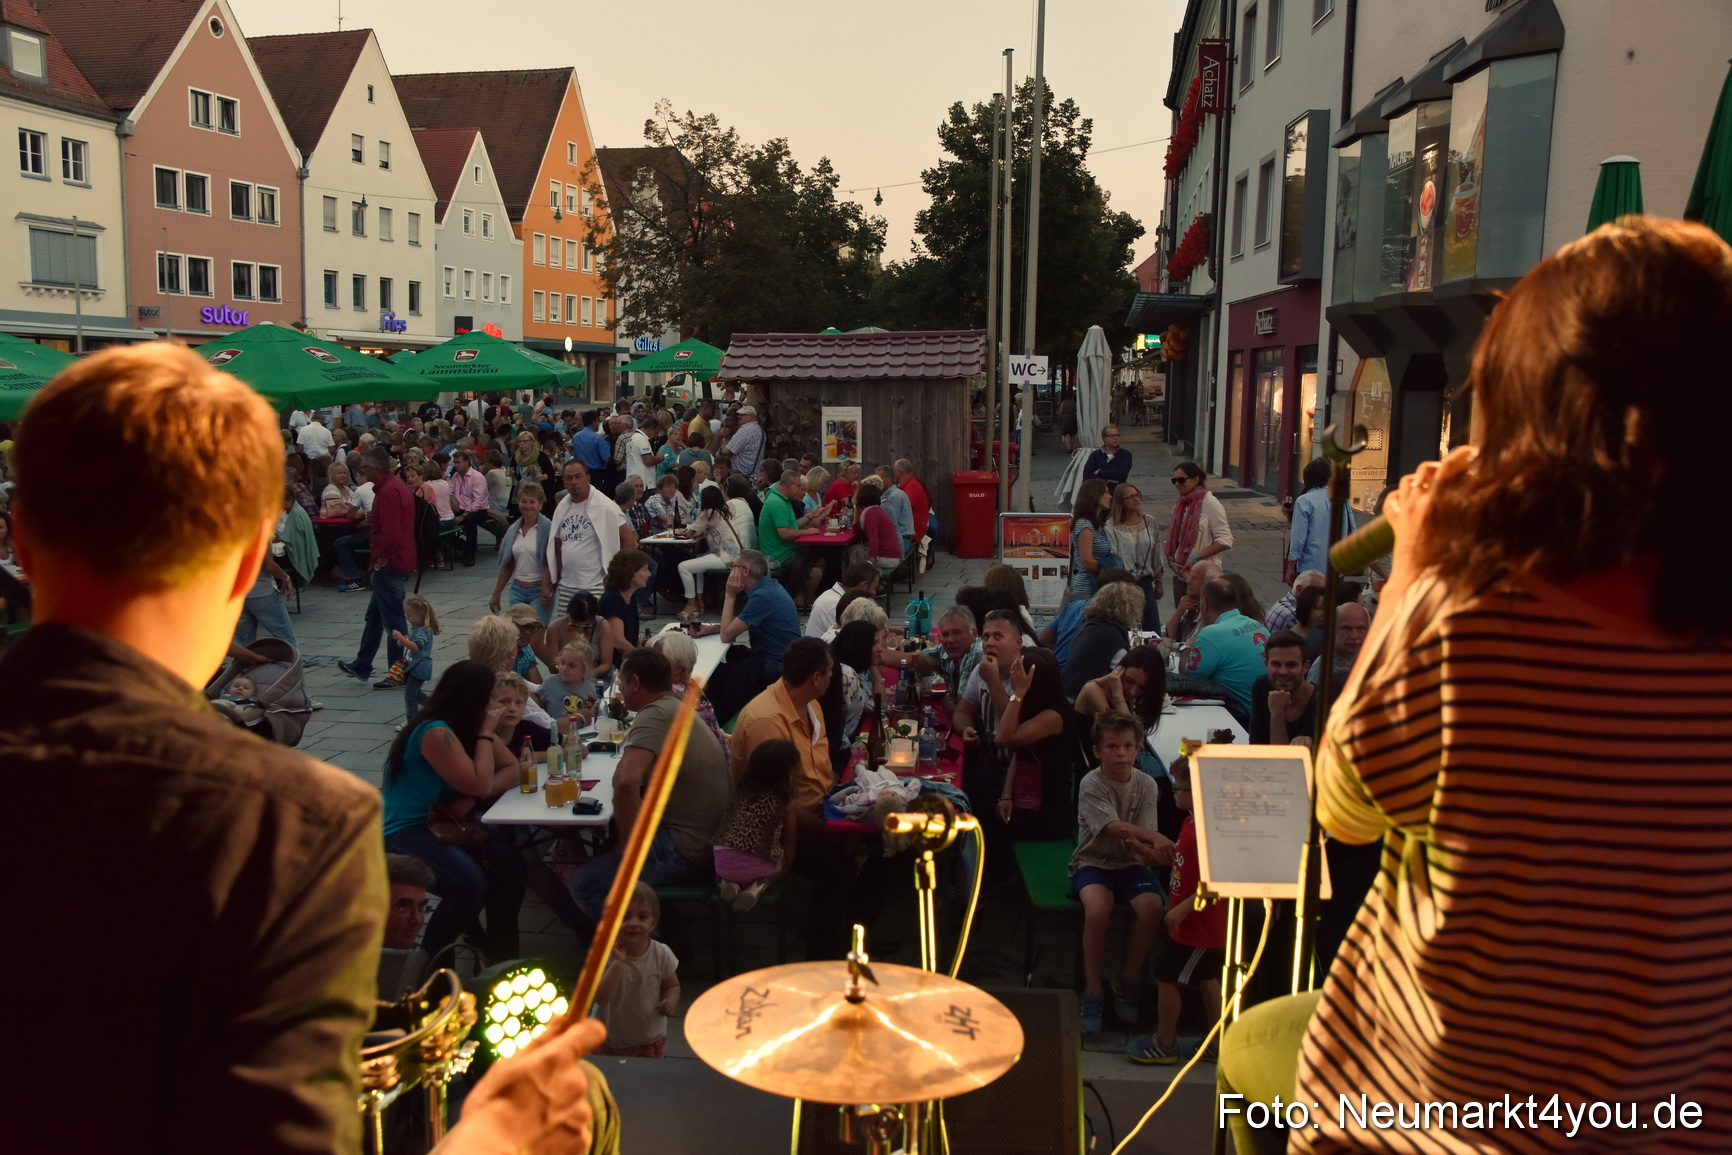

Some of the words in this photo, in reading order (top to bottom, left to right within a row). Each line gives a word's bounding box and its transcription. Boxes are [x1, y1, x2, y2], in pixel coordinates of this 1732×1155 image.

[1203, 55, 1220, 108] Achatz
[634, 336, 658, 352] Gilles
[420, 367, 499, 376] Lammsbräu
[1011, 363, 1037, 376] WC
[561, 515, 592, 530] MUSTANG
[571, 524, 580, 534] M
[1188, 647, 1202, 671] 3
